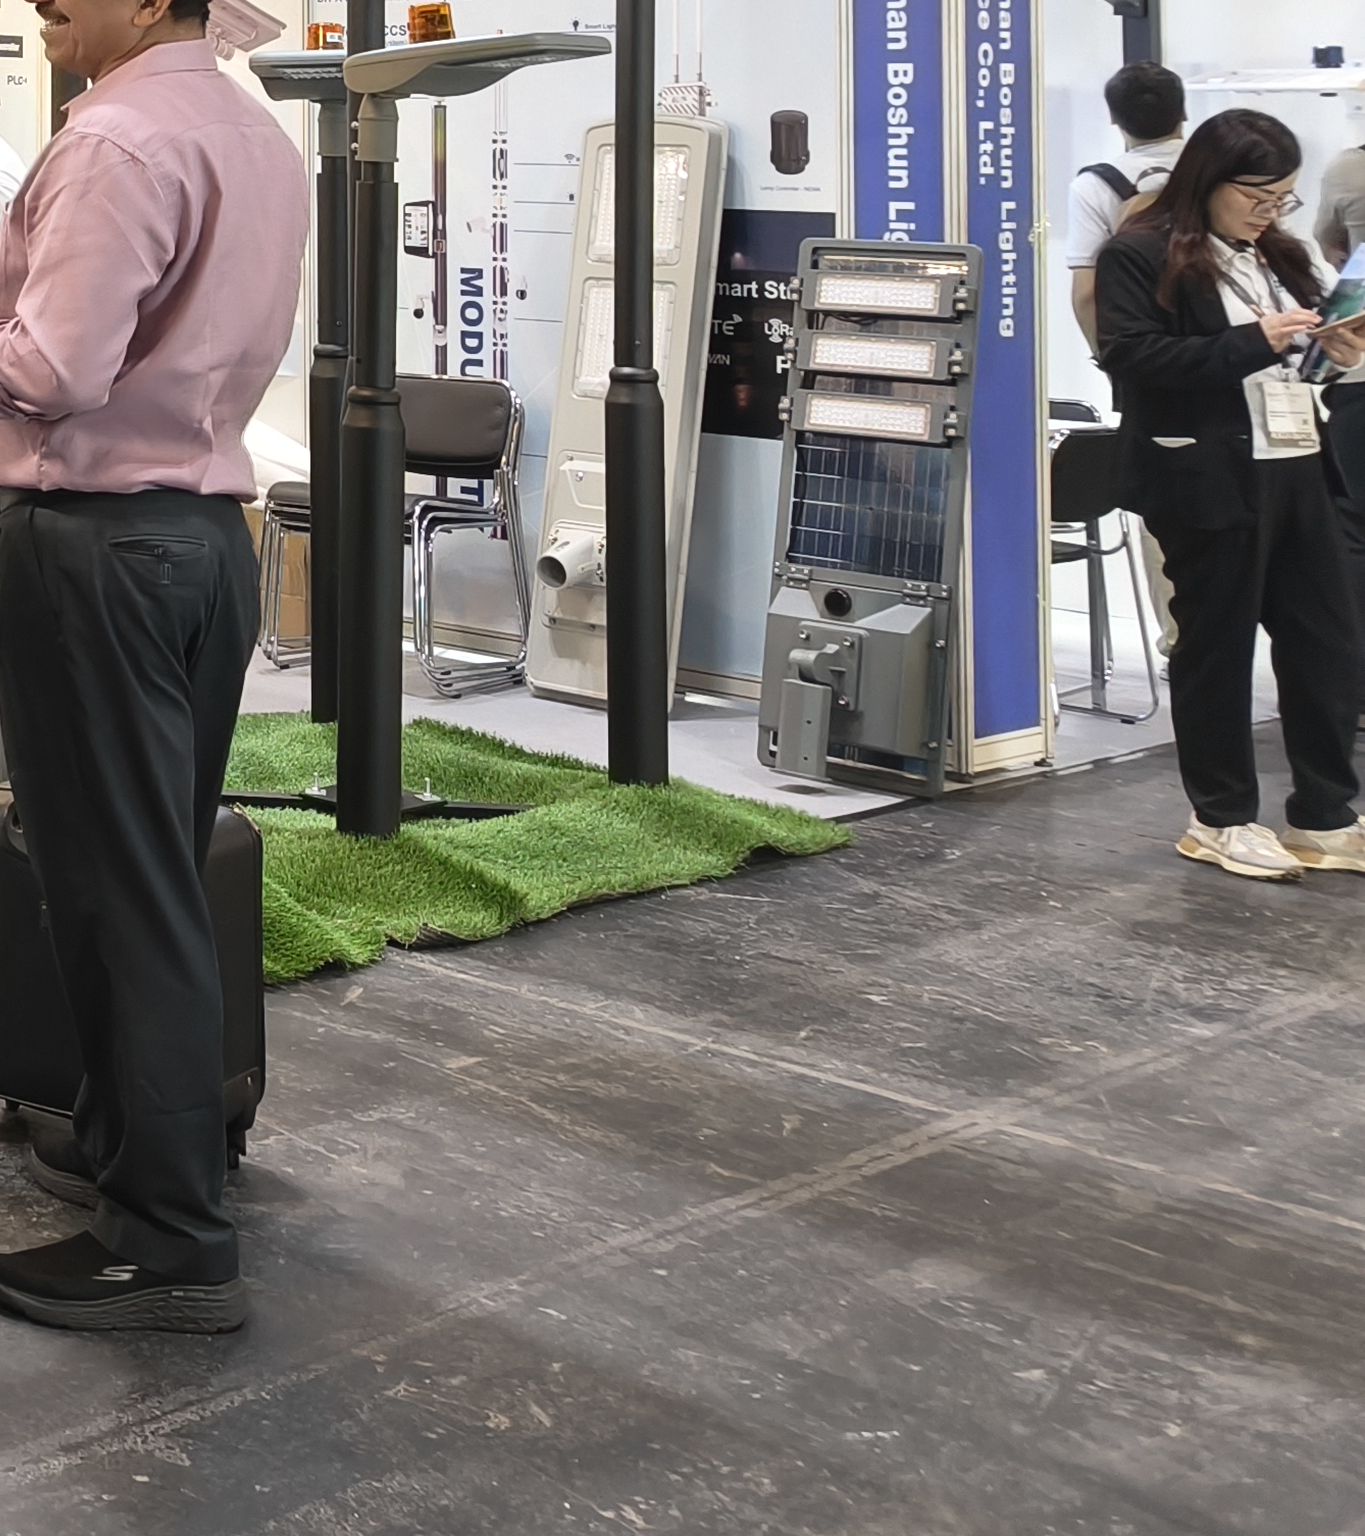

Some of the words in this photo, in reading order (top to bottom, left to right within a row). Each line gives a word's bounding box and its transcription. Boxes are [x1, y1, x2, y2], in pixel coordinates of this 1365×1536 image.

[975, 42, 994, 108] Co.,
[887, 63, 914, 188] Boshun
[977, 122, 994, 185] Ltd.
[1000, 63, 1015, 189] Boshun
[716, 280, 758, 298] mart
[998, 201, 1016, 338] Lighting
